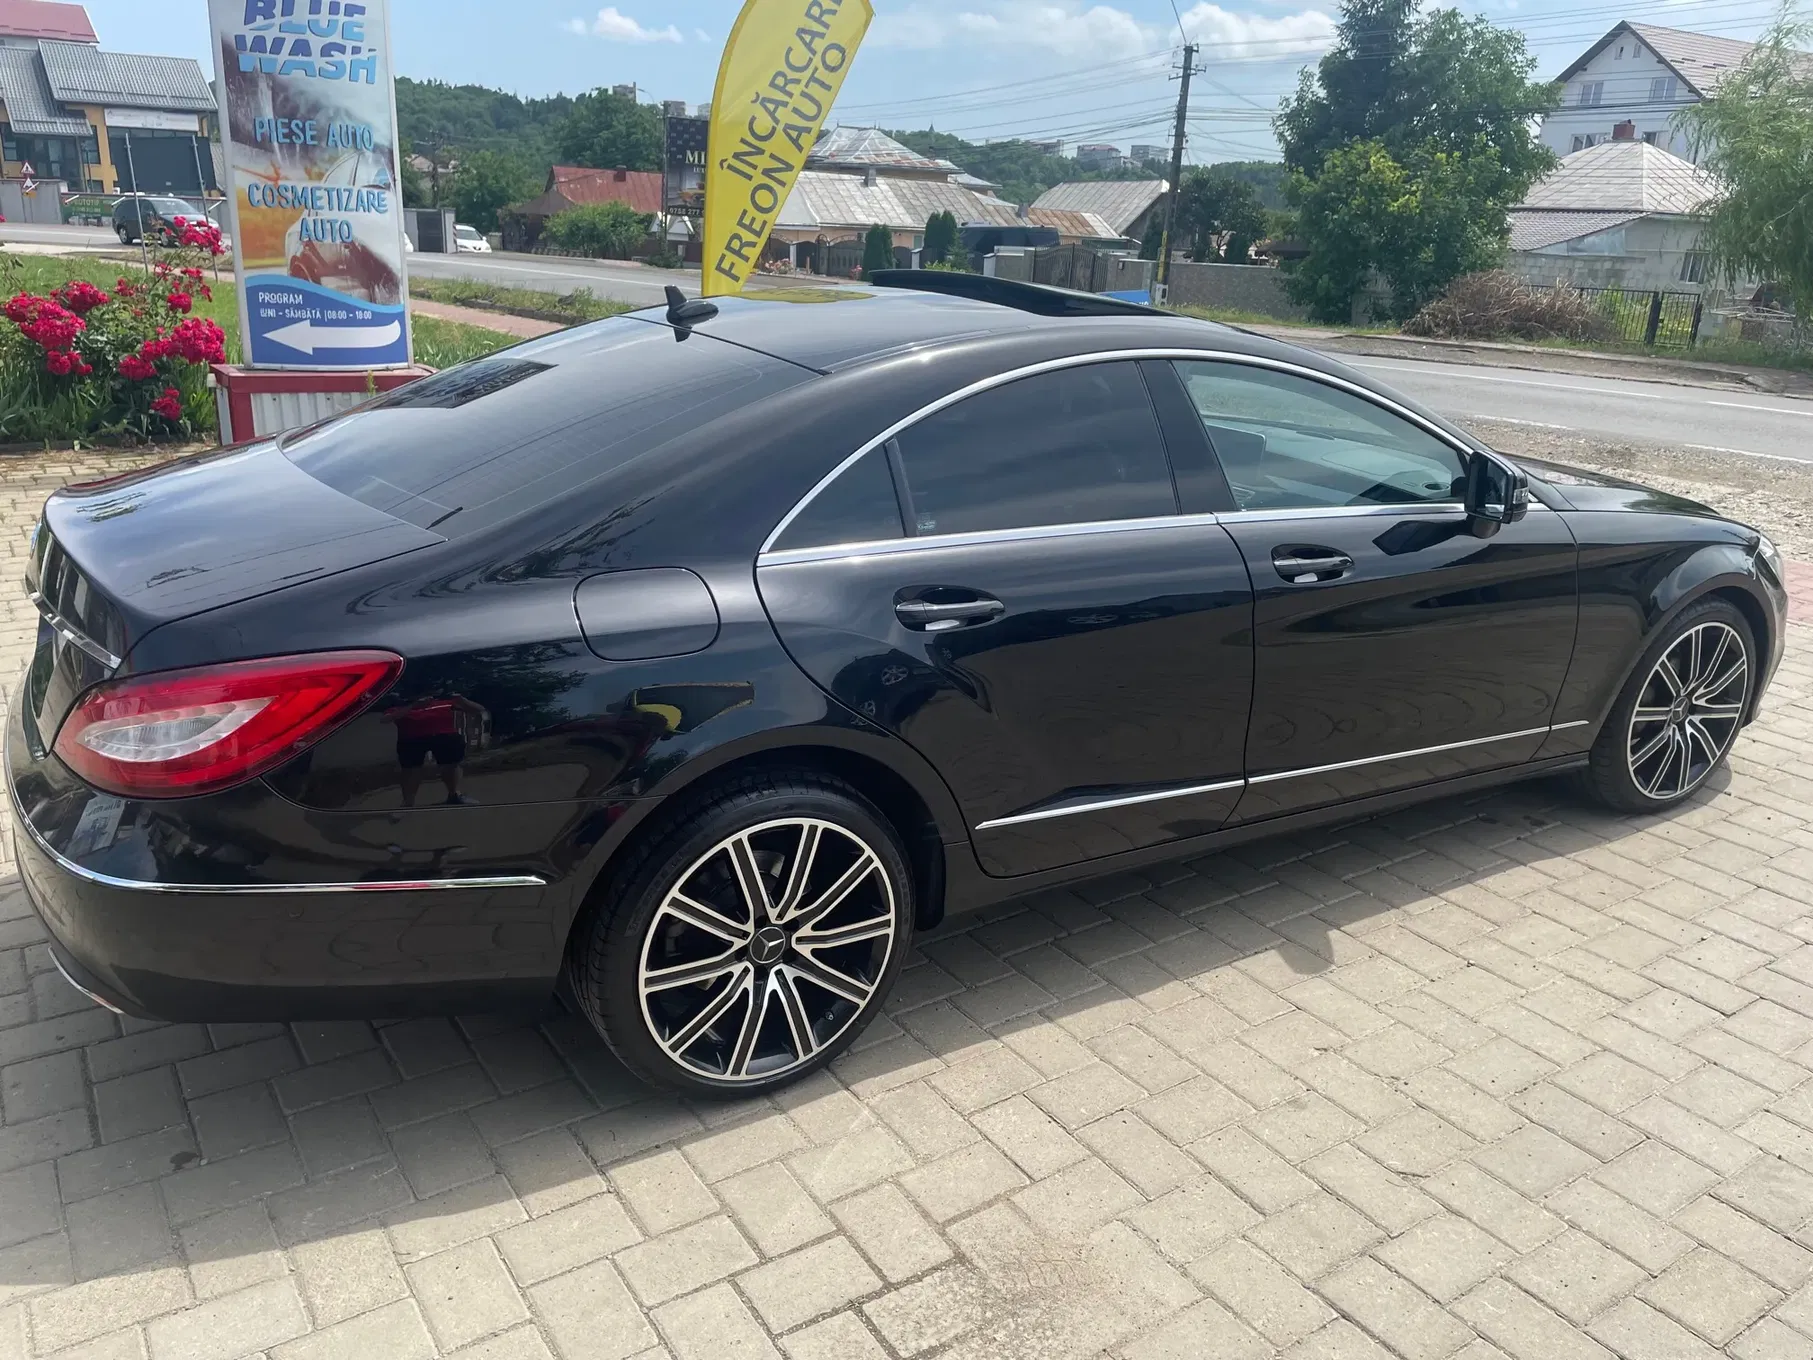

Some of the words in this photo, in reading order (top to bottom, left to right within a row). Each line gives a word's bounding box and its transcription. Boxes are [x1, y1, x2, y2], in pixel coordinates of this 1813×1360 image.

[244, 0, 366, 42] BLUE
[235, 35, 377, 84] WASH
[719, 0, 843, 182] ÎNCĂRCAR
[254, 116, 318, 146] PIESE
[327, 123, 375, 150] AUTO
[685, 150, 706, 165] MI
[715, 152, 795, 283] FREON
[782, 43, 846, 154] AUTO
[248, 183, 389, 213] COSMETIZARE
[300, 217, 354, 243] AUTO
[259, 292, 303, 305] PROGRAM
